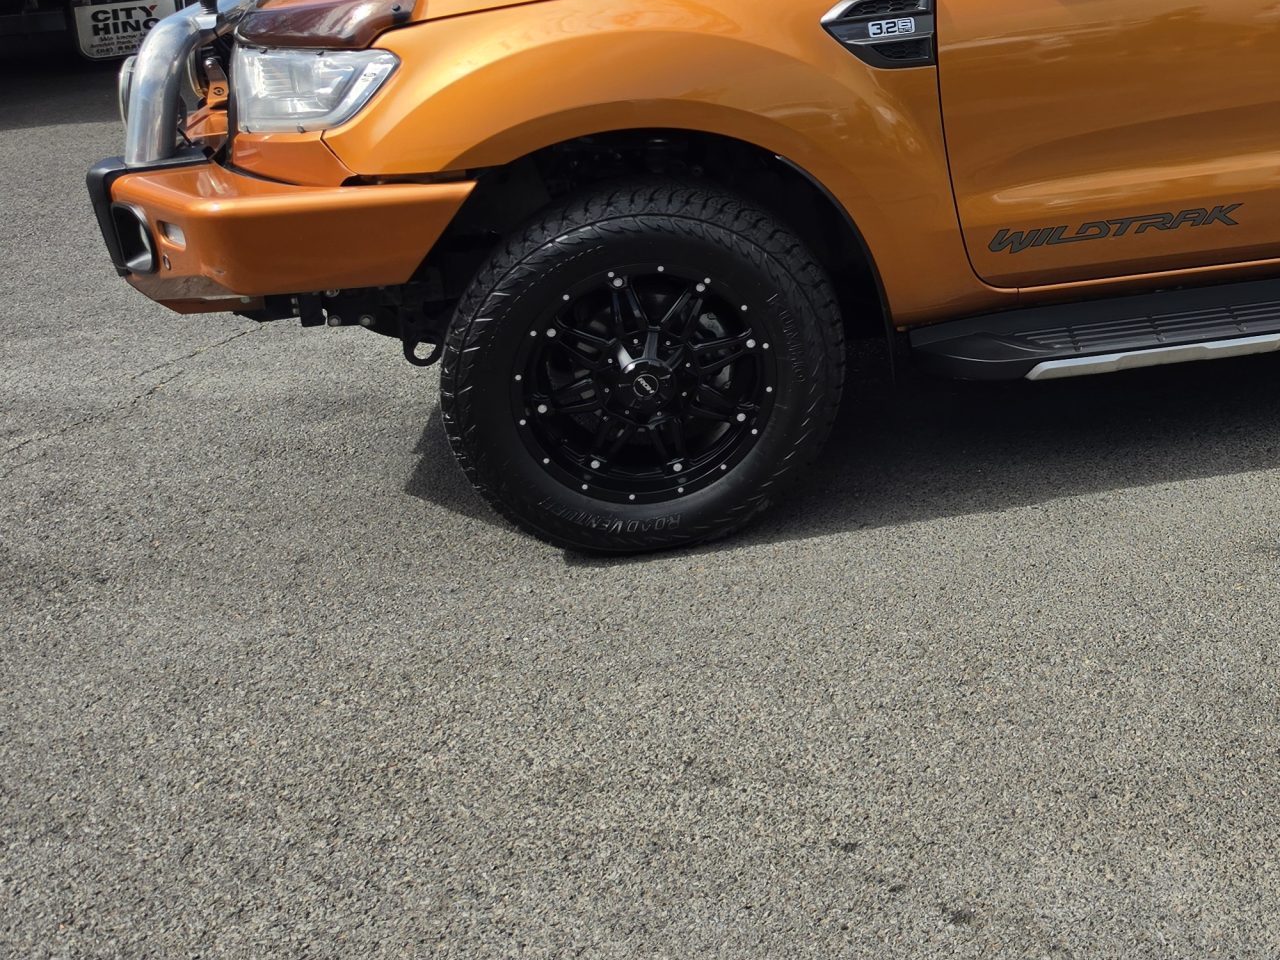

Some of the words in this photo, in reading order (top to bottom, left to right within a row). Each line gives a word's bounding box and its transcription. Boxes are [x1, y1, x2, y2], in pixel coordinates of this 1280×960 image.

[91, 4, 157, 22] CITY
[871, 20, 898, 36] 3.2
[988, 202, 1245, 254] WILDTRAK
